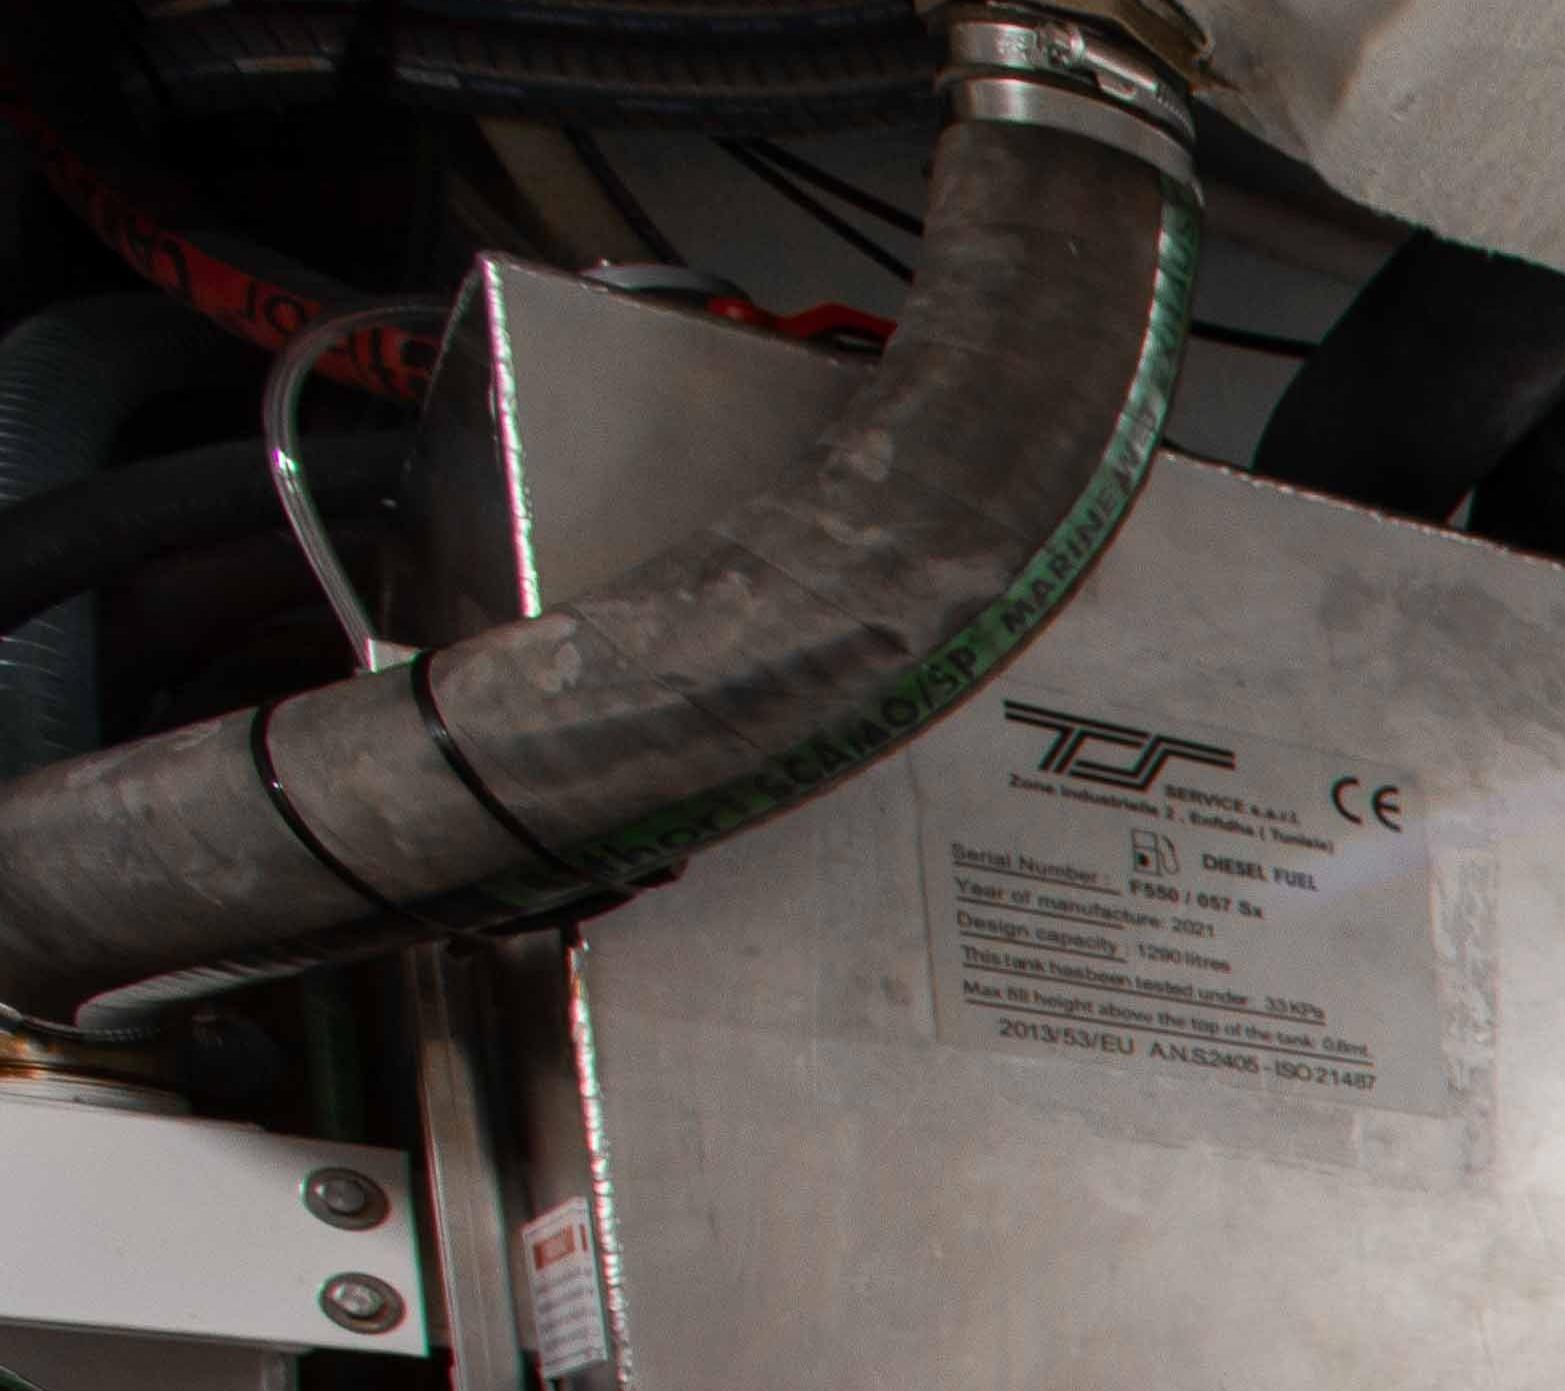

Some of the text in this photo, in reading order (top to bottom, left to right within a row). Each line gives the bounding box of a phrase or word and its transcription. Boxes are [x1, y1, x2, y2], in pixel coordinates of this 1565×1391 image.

[1164, 784, 1245, 816] SERVICE
[952, 842, 1011, 869] Serial
[1202, 852, 1318, 892] DIESEL FUEL
[954, 875, 1007, 899] Year
[1171, 916, 1215, 939] 2021
[957, 909, 1030, 938] Design
[962, 979, 1002, 999] Max
[1156, 1011, 1186, 1028] the
[998, 1017, 1136, 1056] 2013/53/EU
